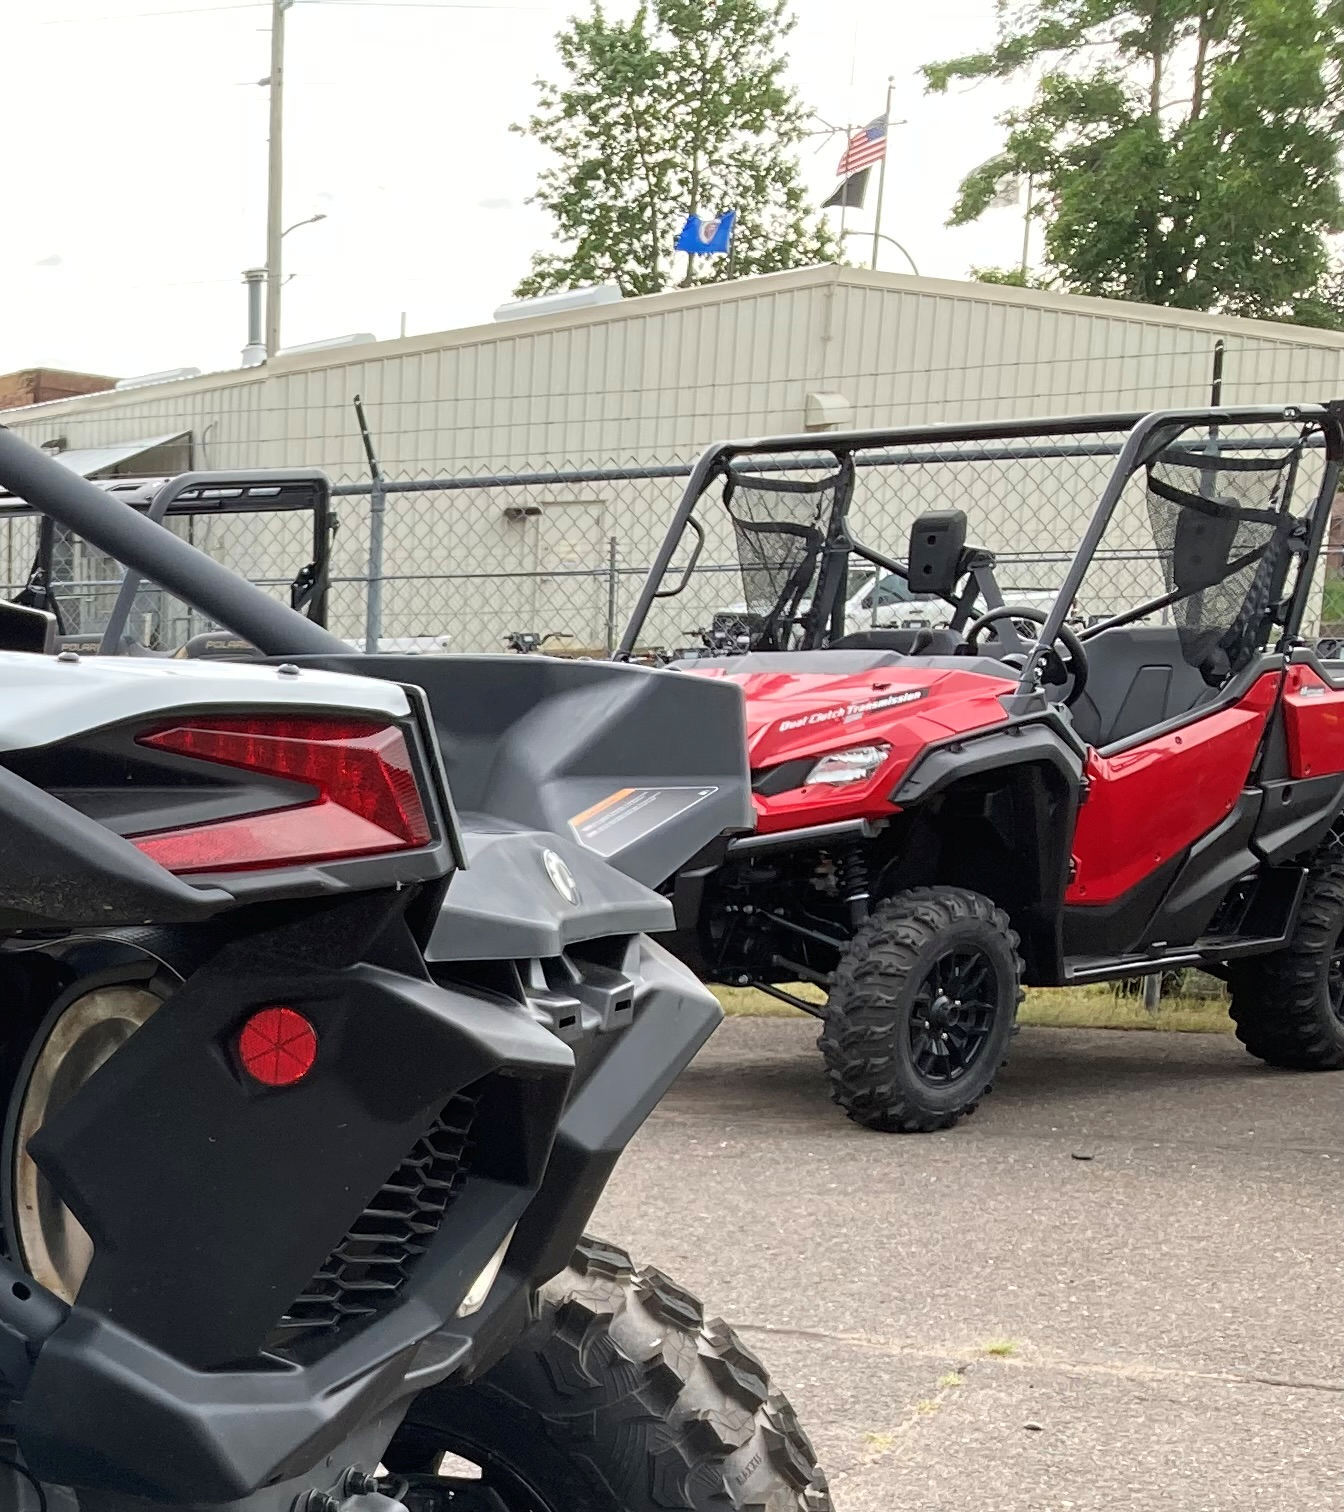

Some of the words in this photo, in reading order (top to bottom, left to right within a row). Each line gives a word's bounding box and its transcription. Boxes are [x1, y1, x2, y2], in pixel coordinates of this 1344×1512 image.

[778, 716, 808, 733] Dual
[809, 707, 846, 725] Clutch
[846, 691, 923, 715] Transmission
